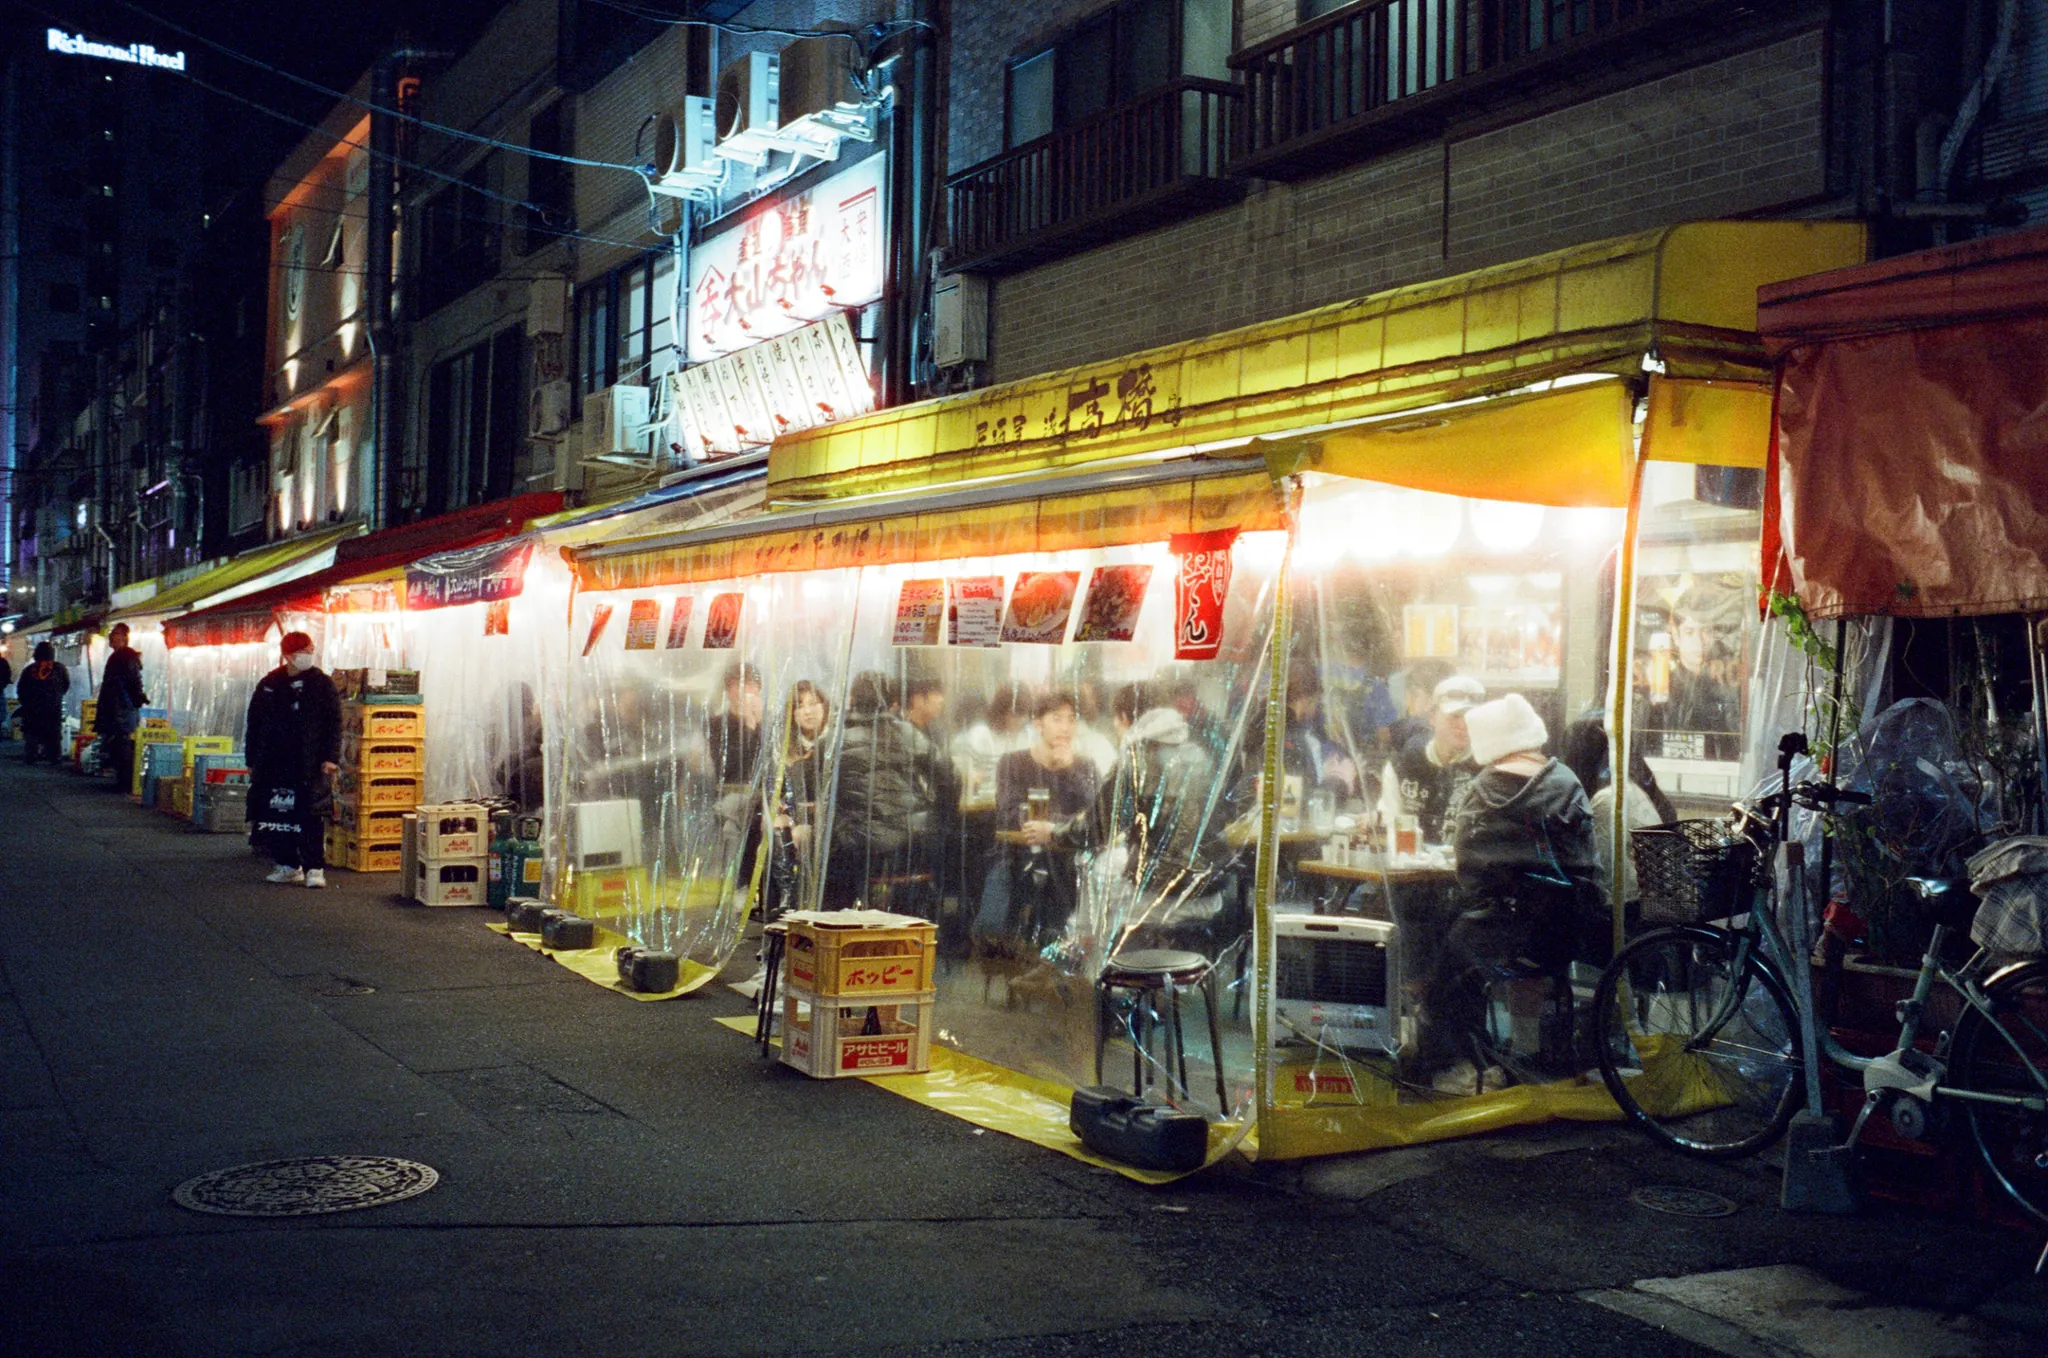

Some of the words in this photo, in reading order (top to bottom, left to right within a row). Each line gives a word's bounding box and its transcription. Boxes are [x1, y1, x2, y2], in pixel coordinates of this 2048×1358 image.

[47, 28, 137, 62] Richmond
[139, 44, 185, 70] Hotel
[1183, 551, 1213, 645] おでん
[375, 723, 413, 734] ホッピー
[374, 757, 412, 768] ホッピー
[374, 790, 412, 801] ホッピー
[257, 821, 303, 833] アサヒビール
[373, 823, 401, 834] ホッピ
[373, 855, 400, 866] ホッピ
[846, 963, 914, 986] ホッピー
[843, 1041, 908, 1057] アサヒビール
